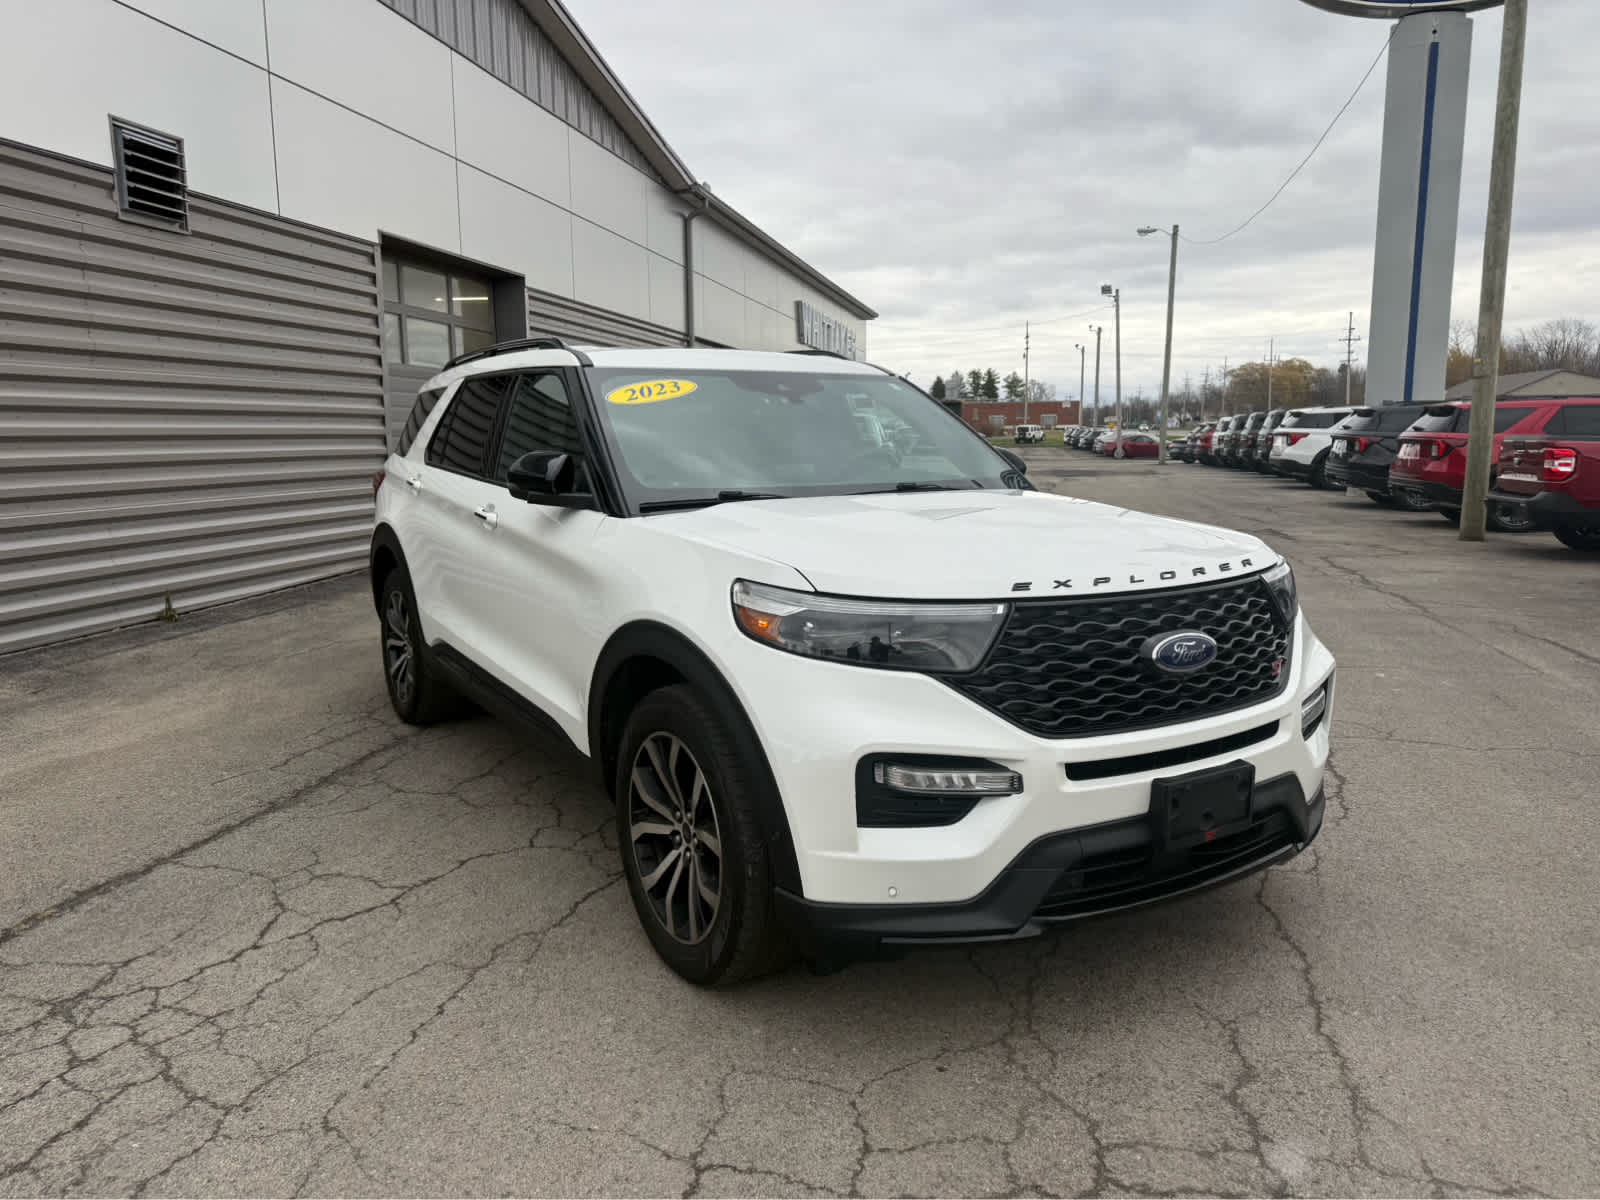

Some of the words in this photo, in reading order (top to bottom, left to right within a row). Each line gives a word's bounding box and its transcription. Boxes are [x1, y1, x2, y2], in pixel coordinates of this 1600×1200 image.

[624, 381, 681, 402] 2023
[1011, 558, 1253, 592] EXPLORER
[1172, 640, 1207, 665] Ford
